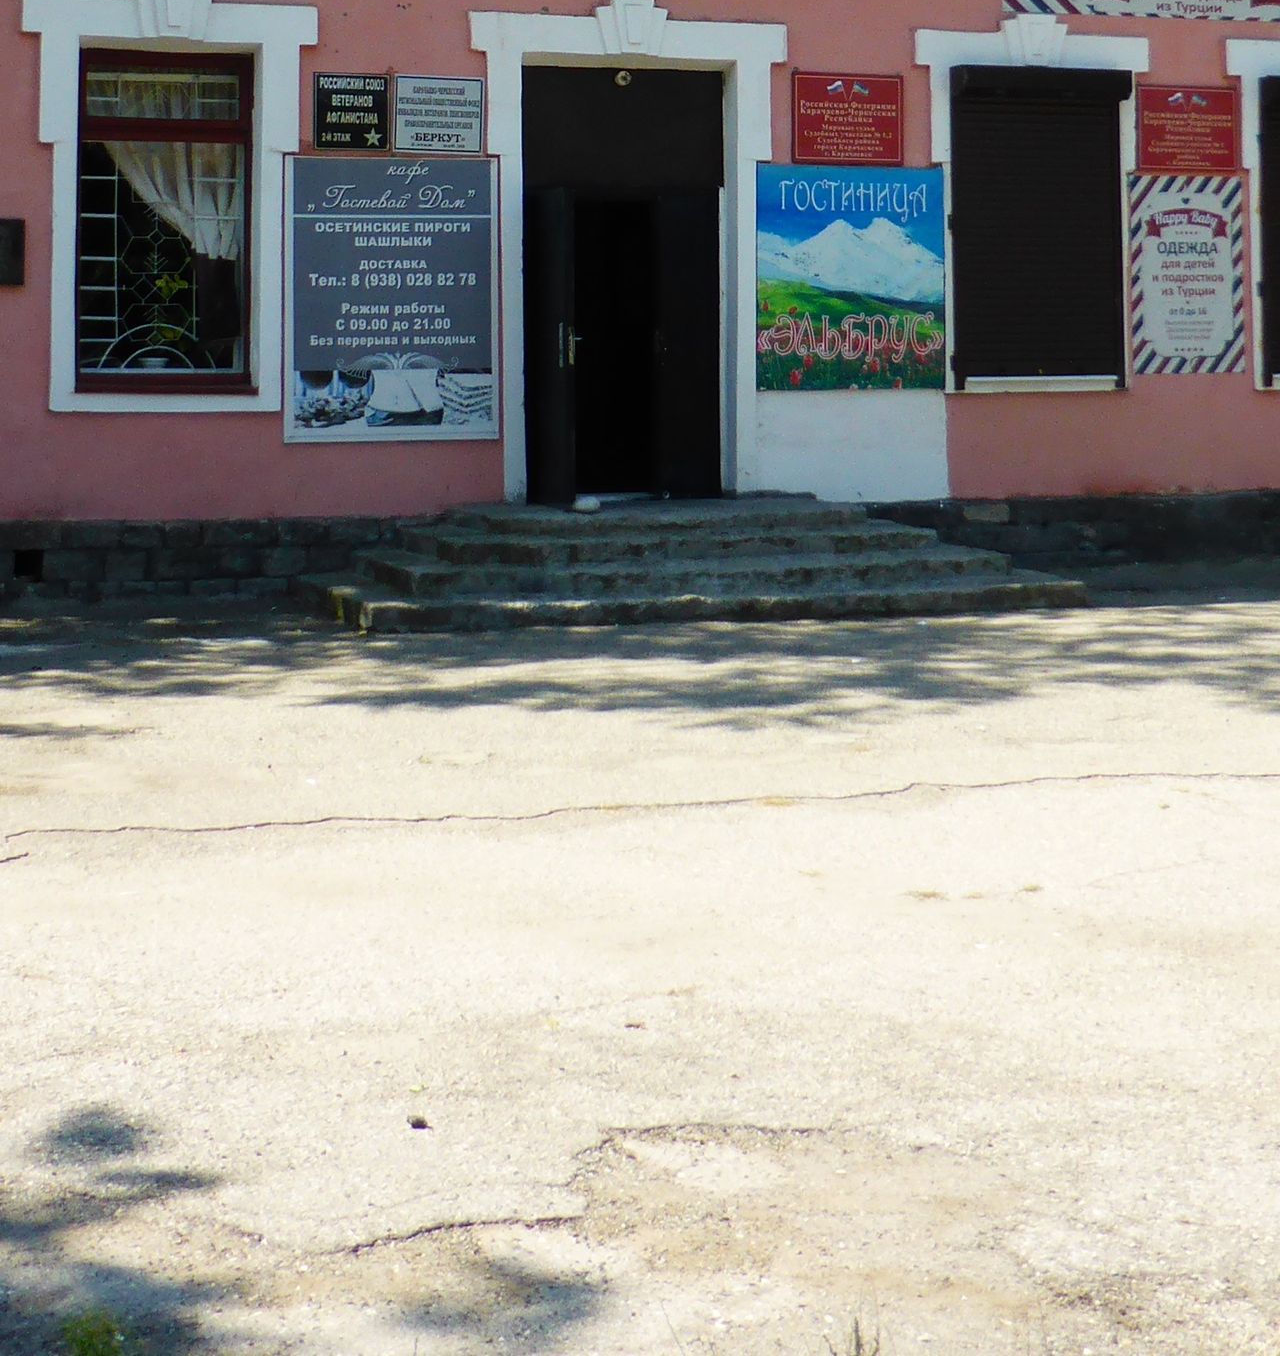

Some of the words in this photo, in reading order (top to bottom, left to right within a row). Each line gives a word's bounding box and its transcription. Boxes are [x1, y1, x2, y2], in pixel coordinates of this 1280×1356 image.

[1156, 3, 1171, 12] из
[1175, 2, 1223, 15] Турции
[319, 77, 364, 90] РОССИЙСКИЙ
[365, 78, 385, 91] СОЮЗ
[331, 94, 373, 107] ВЕТЕРАНОВ
[326, 110, 378, 124] АФГАНИСТАНА
[333, 132, 351, 142] ЭТАЖ
[410, 132, 466, 143] «БЕРКУТ»
[386, 160, 429, 184] кафе
[779, 179, 928, 222] ГОСТИНИЦА
[1153, 211, 1188, 225] Happy
[1191, 211, 1218, 229] Baby
[314, 222, 410, 233] ОСЕТИНСКИЕ
[414, 222, 471, 233] ПИРОГИ
[354, 236, 432, 247] ШАШЛЫКИ
[1157, 241, 1218, 256] ОДЕЖДА
[359, 259, 428, 270] ДОСТАВКА
[1160, 261, 1180, 270] для
[1183, 258, 1216, 270] детей
[308, 273, 347, 287] Тел.:
[351, 273, 360, 287] 8
[364, 273, 402, 289] (938)
[436, 273, 455, 287] 82
[458, 272, 477, 286] 78
[1152, 274, 1159, 282] и
[1161, 273, 1224, 285] подростков
[1161, 287, 1174, 296] из
[1177, 285, 1216, 298] Турции
[341, 302, 390, 314] Режим
[394, 302, 446, 316] работы
[335, 319, 345, 330] С
[350, 319, 388, 330] 09.00
[392, 321, 409, 332] до
[413, 318, 451, 330] 21.00
[310, 335, 334, 346] Без
[337, 336, 398, 347] перерыва
[402, 336, 410, 344] и
[413, 335, 477, 345] выходных
[757, 311, 944, 363] «ЭЛЬБРУС»
